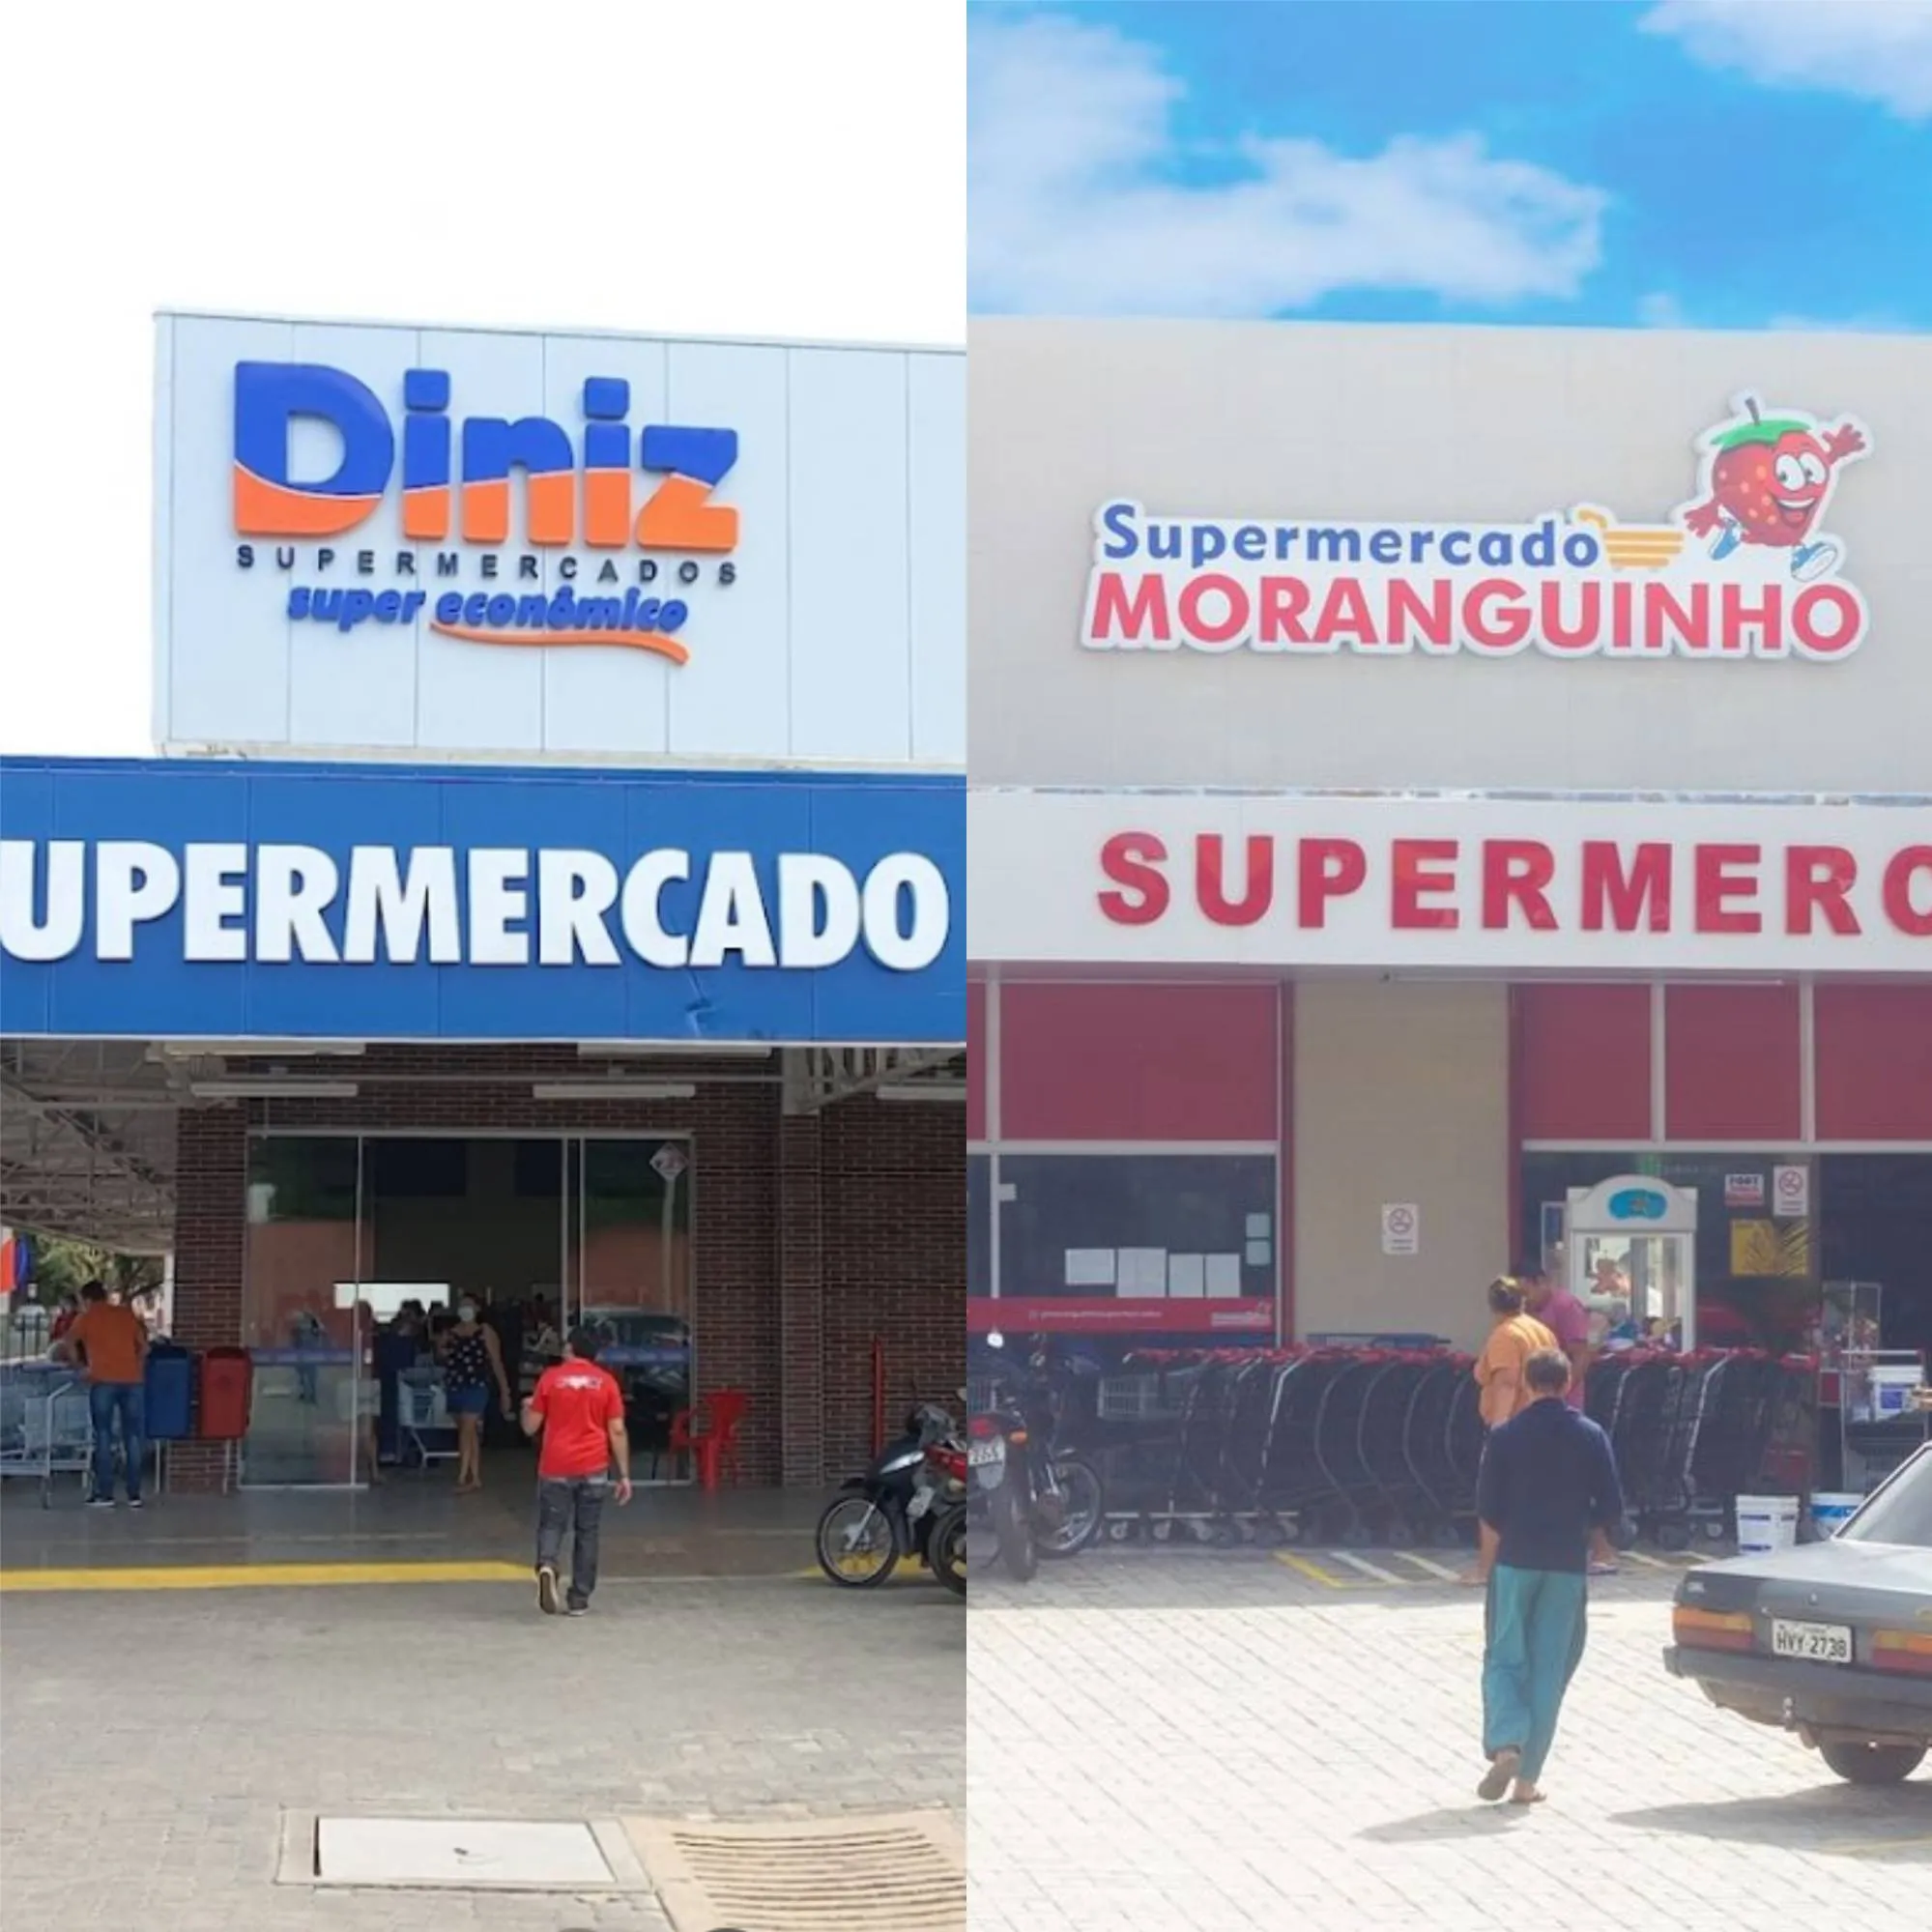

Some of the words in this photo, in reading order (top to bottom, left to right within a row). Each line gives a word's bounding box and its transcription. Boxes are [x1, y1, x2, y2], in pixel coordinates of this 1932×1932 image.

[233, 360, 738, 551] Diniz
[236, 544, 737, 586] SUPERMERCADOS
[1102, 503, 1601, 569] Supermercado
[287, 586, 426, 631] super
[435, 586, 688, 632] econômico
[1089, 572, 1863, 652] MORANGUINHO
